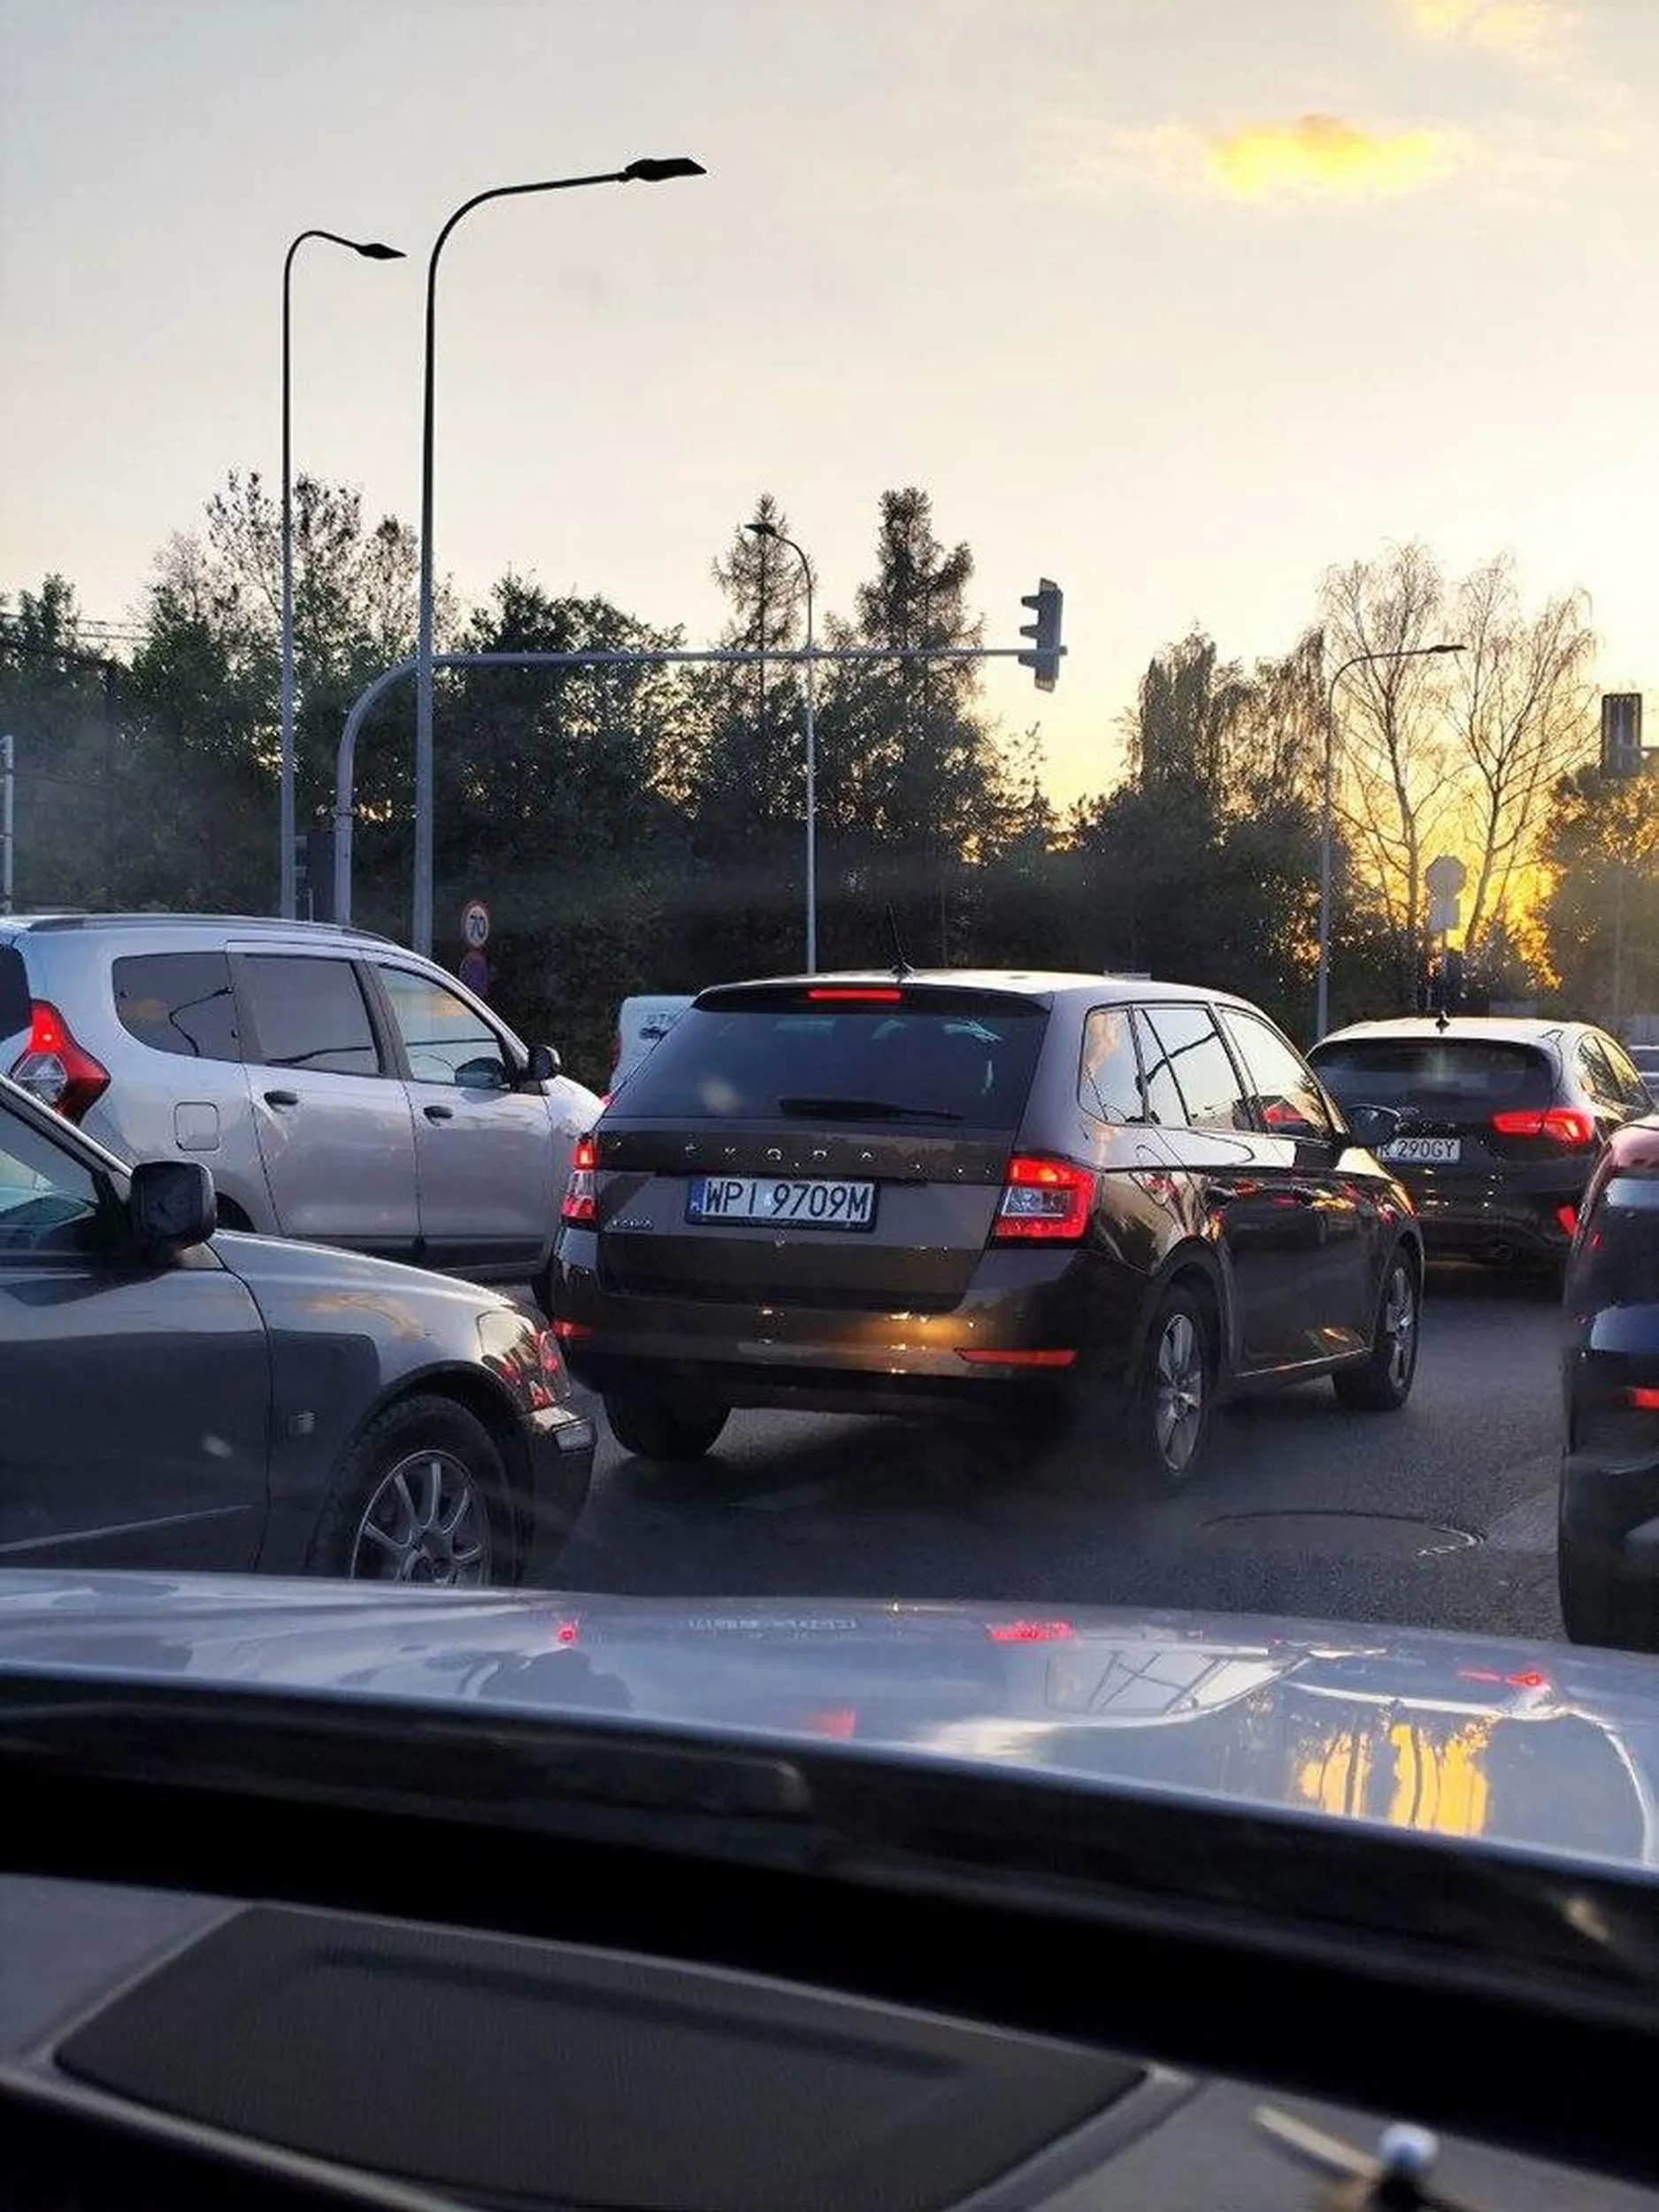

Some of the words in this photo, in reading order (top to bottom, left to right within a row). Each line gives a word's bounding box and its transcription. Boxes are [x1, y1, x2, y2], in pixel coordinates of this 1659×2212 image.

[470, 914, 486, 938] 70
[1397, 1140, 1455, 1157] 290GY
[705, 1181, 757, 1214] WPI
[771, 1183, 870, 1218] 9709M
